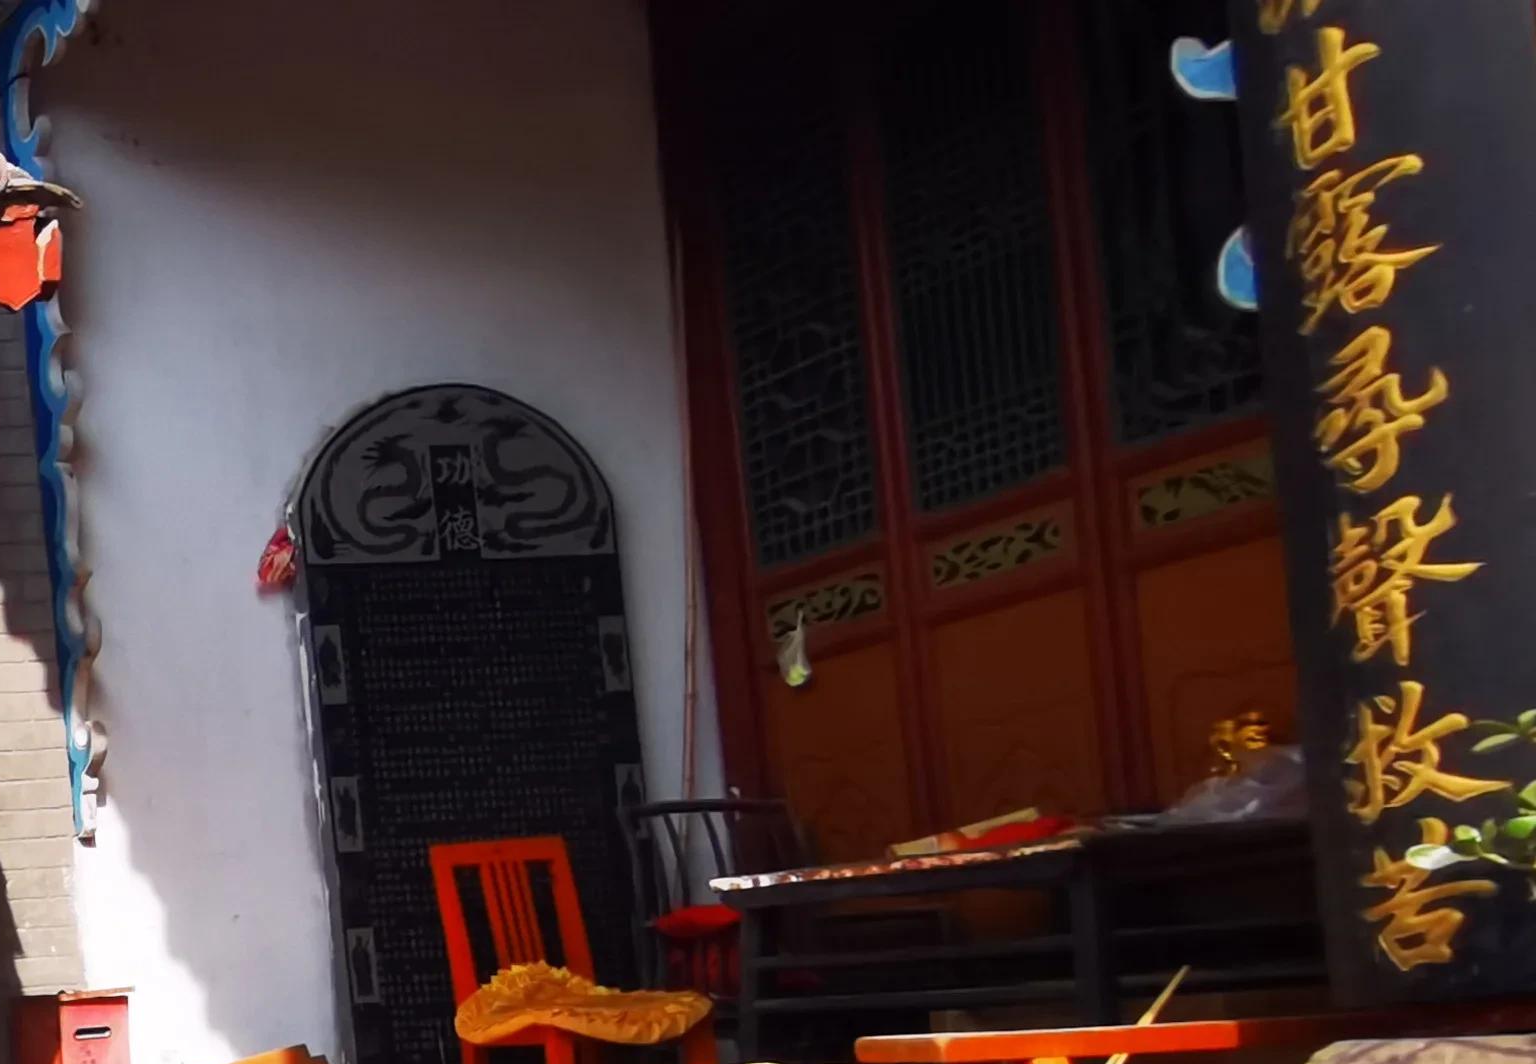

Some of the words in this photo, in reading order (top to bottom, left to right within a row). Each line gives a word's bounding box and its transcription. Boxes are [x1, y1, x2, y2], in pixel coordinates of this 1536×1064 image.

[435, 452, 486, 551] 功德
[1258, 0, 1512, 969] 甘露尋聲救苦
